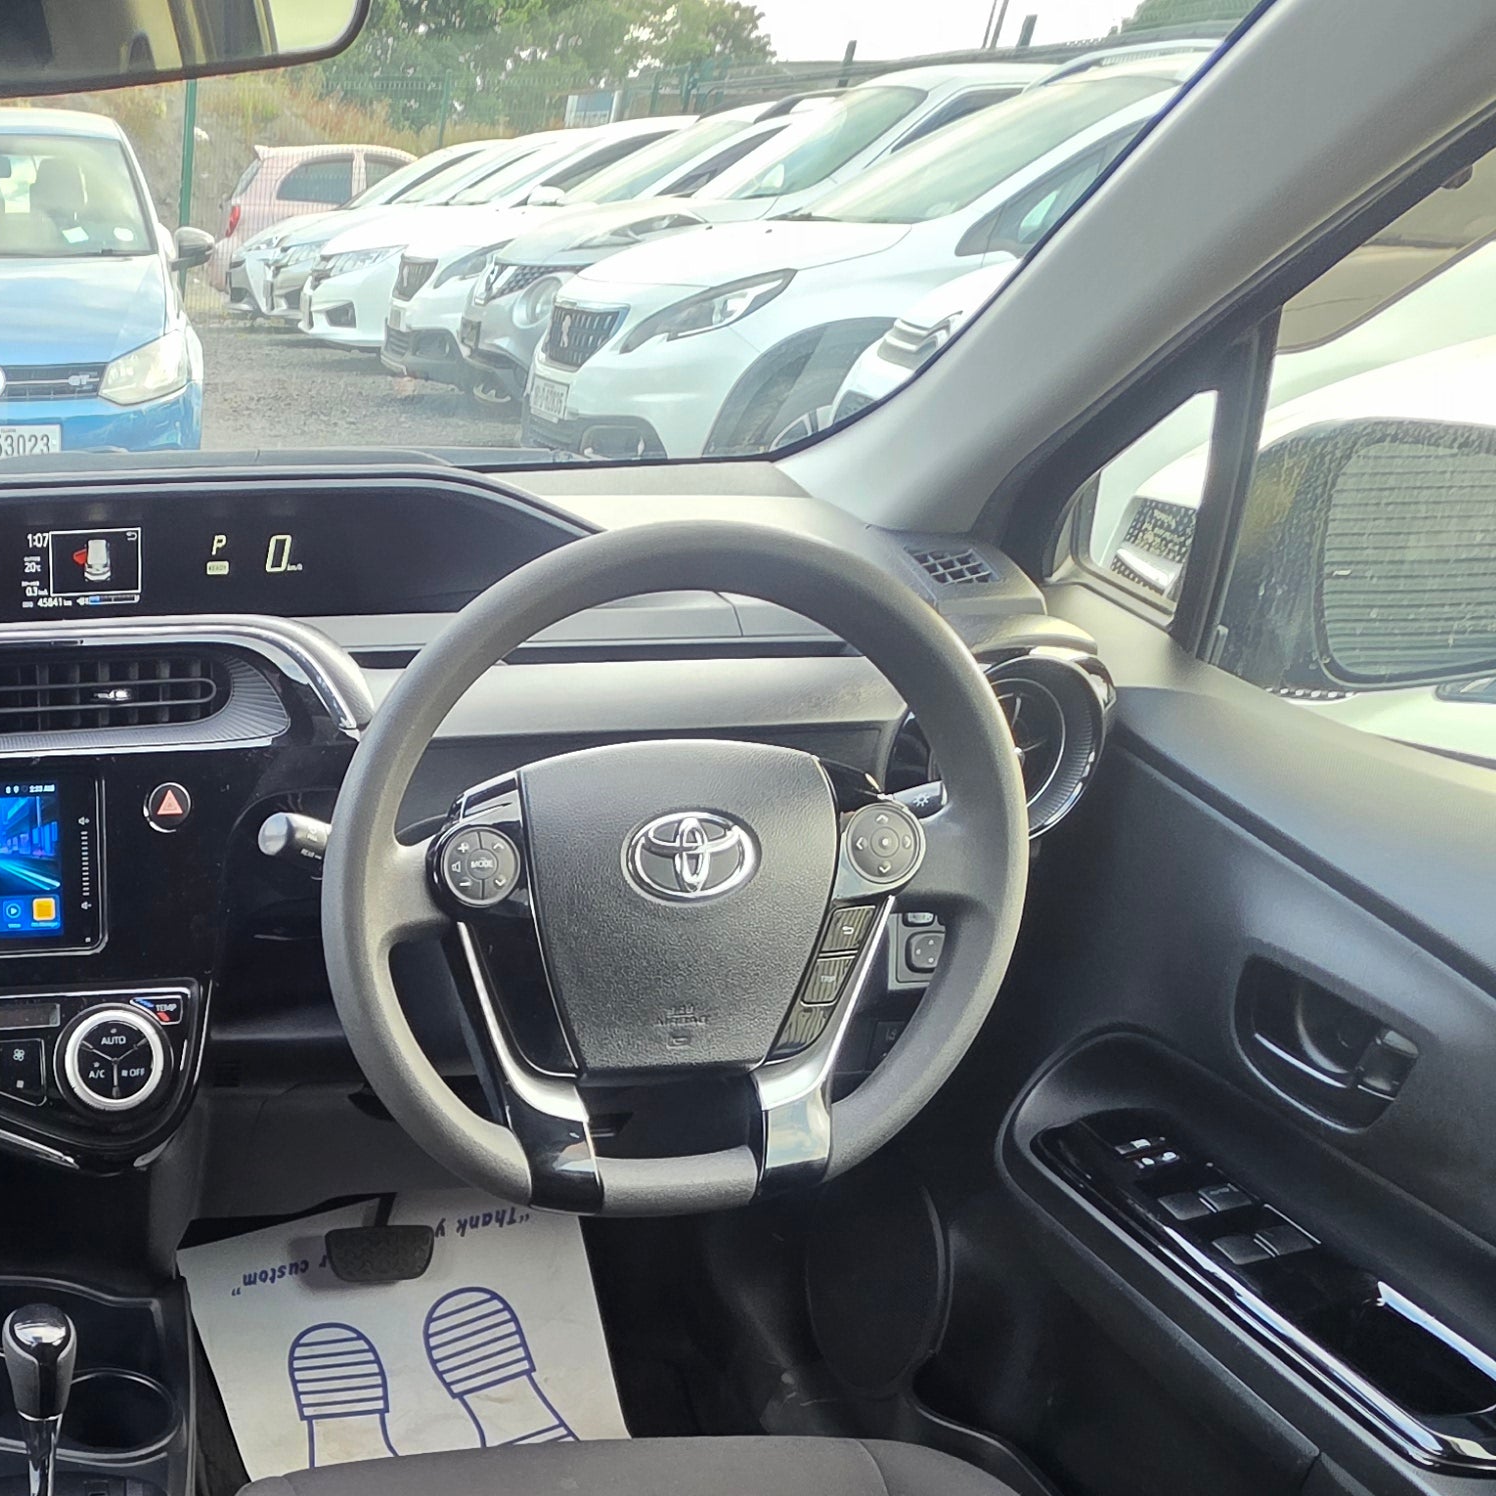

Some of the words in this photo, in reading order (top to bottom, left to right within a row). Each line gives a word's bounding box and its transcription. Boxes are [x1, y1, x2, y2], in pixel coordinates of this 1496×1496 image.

[27, 532, 49, 549] 1:07
[211, 534, 227, 556] P
[265, 534, 292, 573] 0
[155, 1003, 178, 1012] TEMP
[101, 1035, 127, 1046] AUTO
[88, 1069, 105, 1079] A/C
[129, 1067, 145, 1078] OFF
